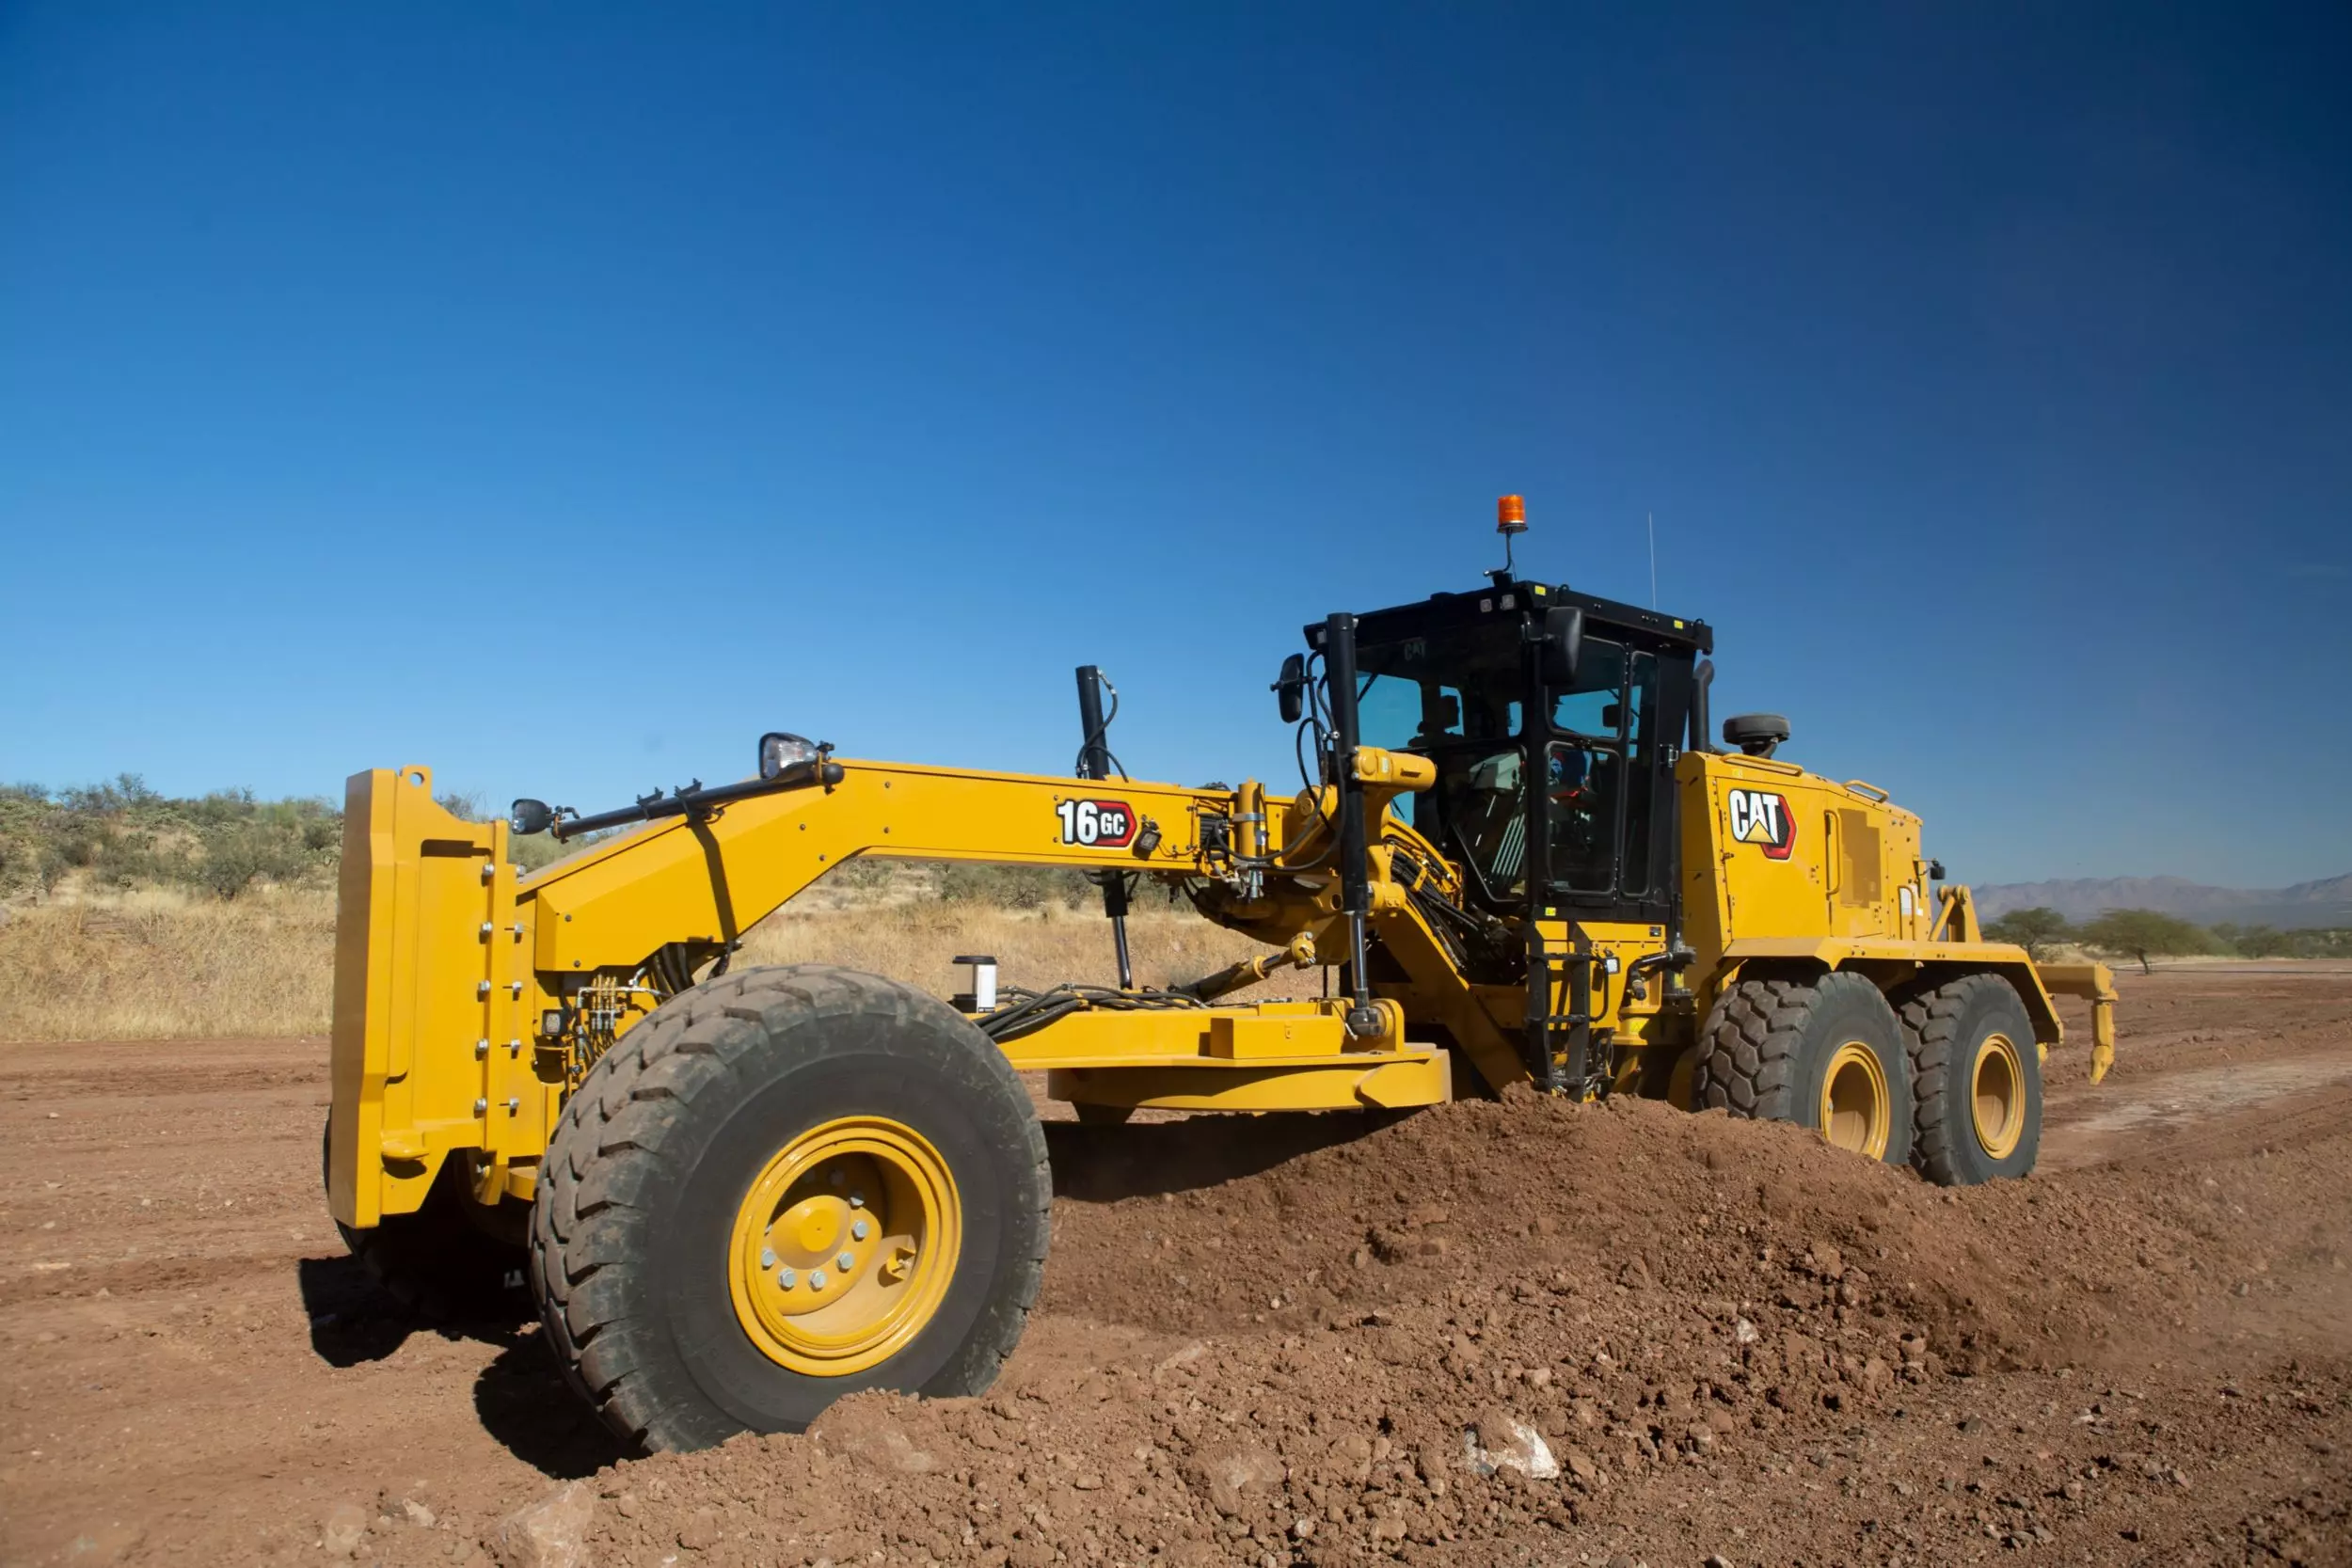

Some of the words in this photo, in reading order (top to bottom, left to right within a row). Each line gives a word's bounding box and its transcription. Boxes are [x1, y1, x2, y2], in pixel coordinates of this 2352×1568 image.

[1404, 640, 1426, 661] CAT
[1057, 800, 1098, 844] 16
[1100, 813, 1125, 836] GC
[1729, 789, 1779, 844] CAT
